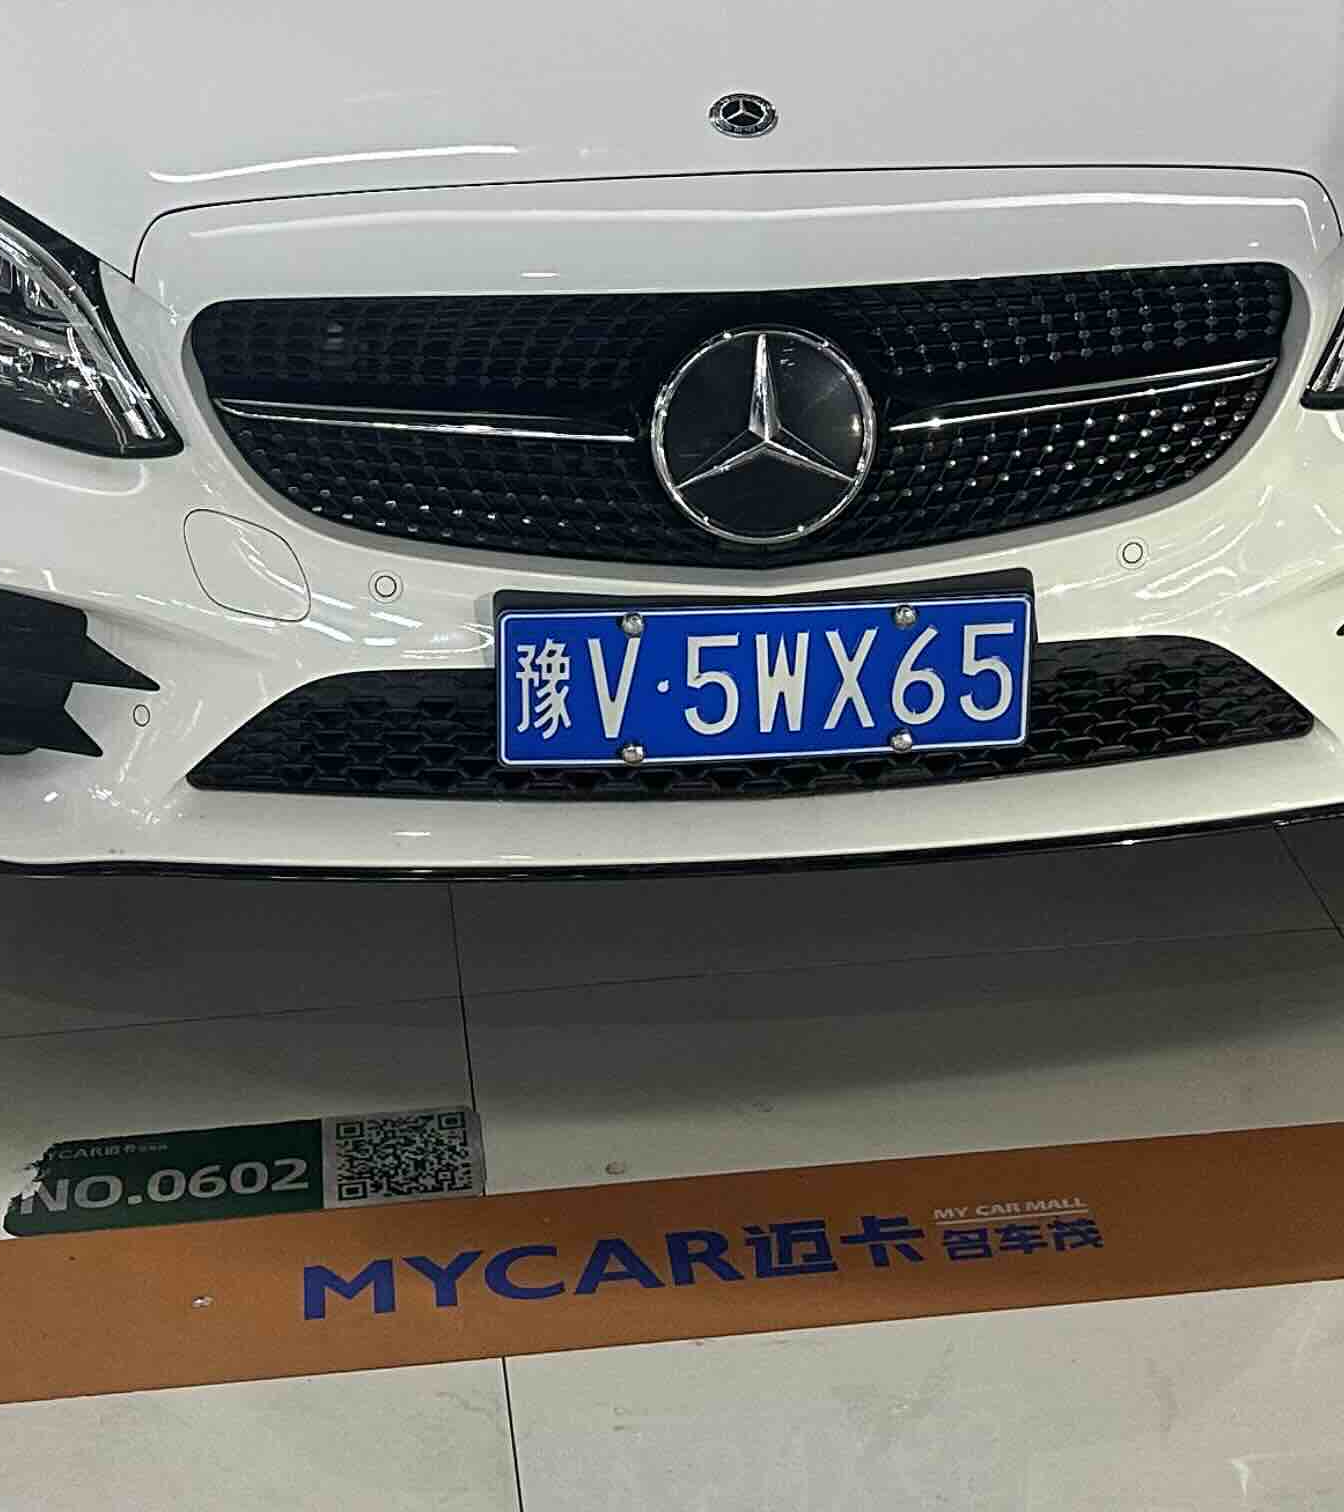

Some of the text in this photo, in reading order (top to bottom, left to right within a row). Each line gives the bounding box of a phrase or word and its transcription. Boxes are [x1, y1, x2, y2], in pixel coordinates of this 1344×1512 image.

[515, 619, 1016, 741] 豫V·5WX65
[17, 1157, 310, 1217] NO.0602
[933, 1196, 1089, 1220] MY CAR MALL
[941, 1218, 1105, 1260] 名车茂
